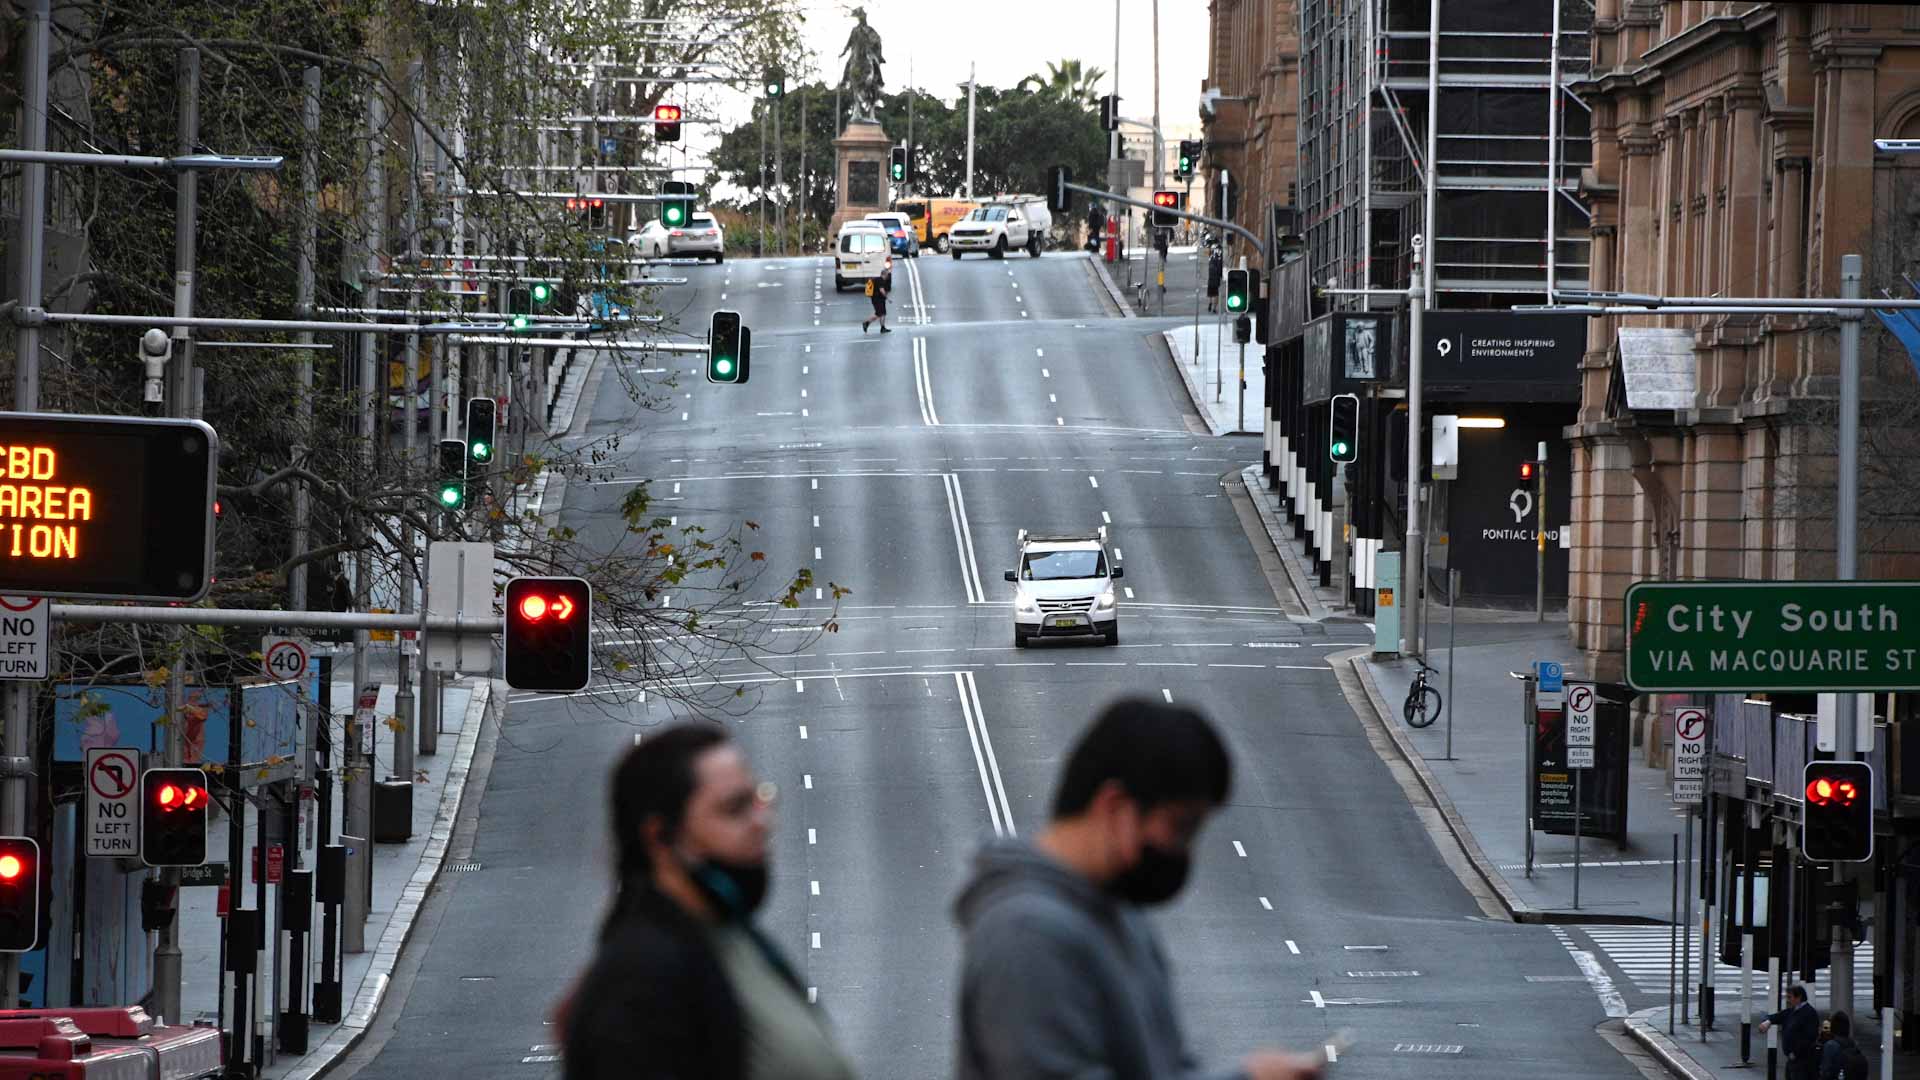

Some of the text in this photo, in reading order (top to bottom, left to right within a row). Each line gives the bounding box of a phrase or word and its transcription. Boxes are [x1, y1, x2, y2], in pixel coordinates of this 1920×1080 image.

[1471, 349, 1534, 357] ENVIRONMENTS
[0, 485, 91, 520] AREA
[1482, 529, 1559, 540] PONTIAC LND
[0, 523, 77, 558] ION
[2, 617, 34, 636] NO
[1667, 603, 1752, 639] City
[1780, 603, 1898, 632] South
[271, 652, 300, 672] 40
[1649, 649, 1916, 671] VIA MACQUARIE ST
[1573, 715, 1588, 725] NO
[1570, 735, 1590, 743] TURN
[1682, 743, 1700, 754] NO
[1678, 756, 1703, 764] RIGHT
[1680, 767, 1704, 775] TURN
[1541, 783, 1574, 791] boundary
[1541, 790, 1568, 798] pushing
[99, 802, 127, 818] NO
[96, 823, 131, 834] LEFT
[93, 838, 131, 850] TURN
[182, 867, 212, 880] Bridge St
